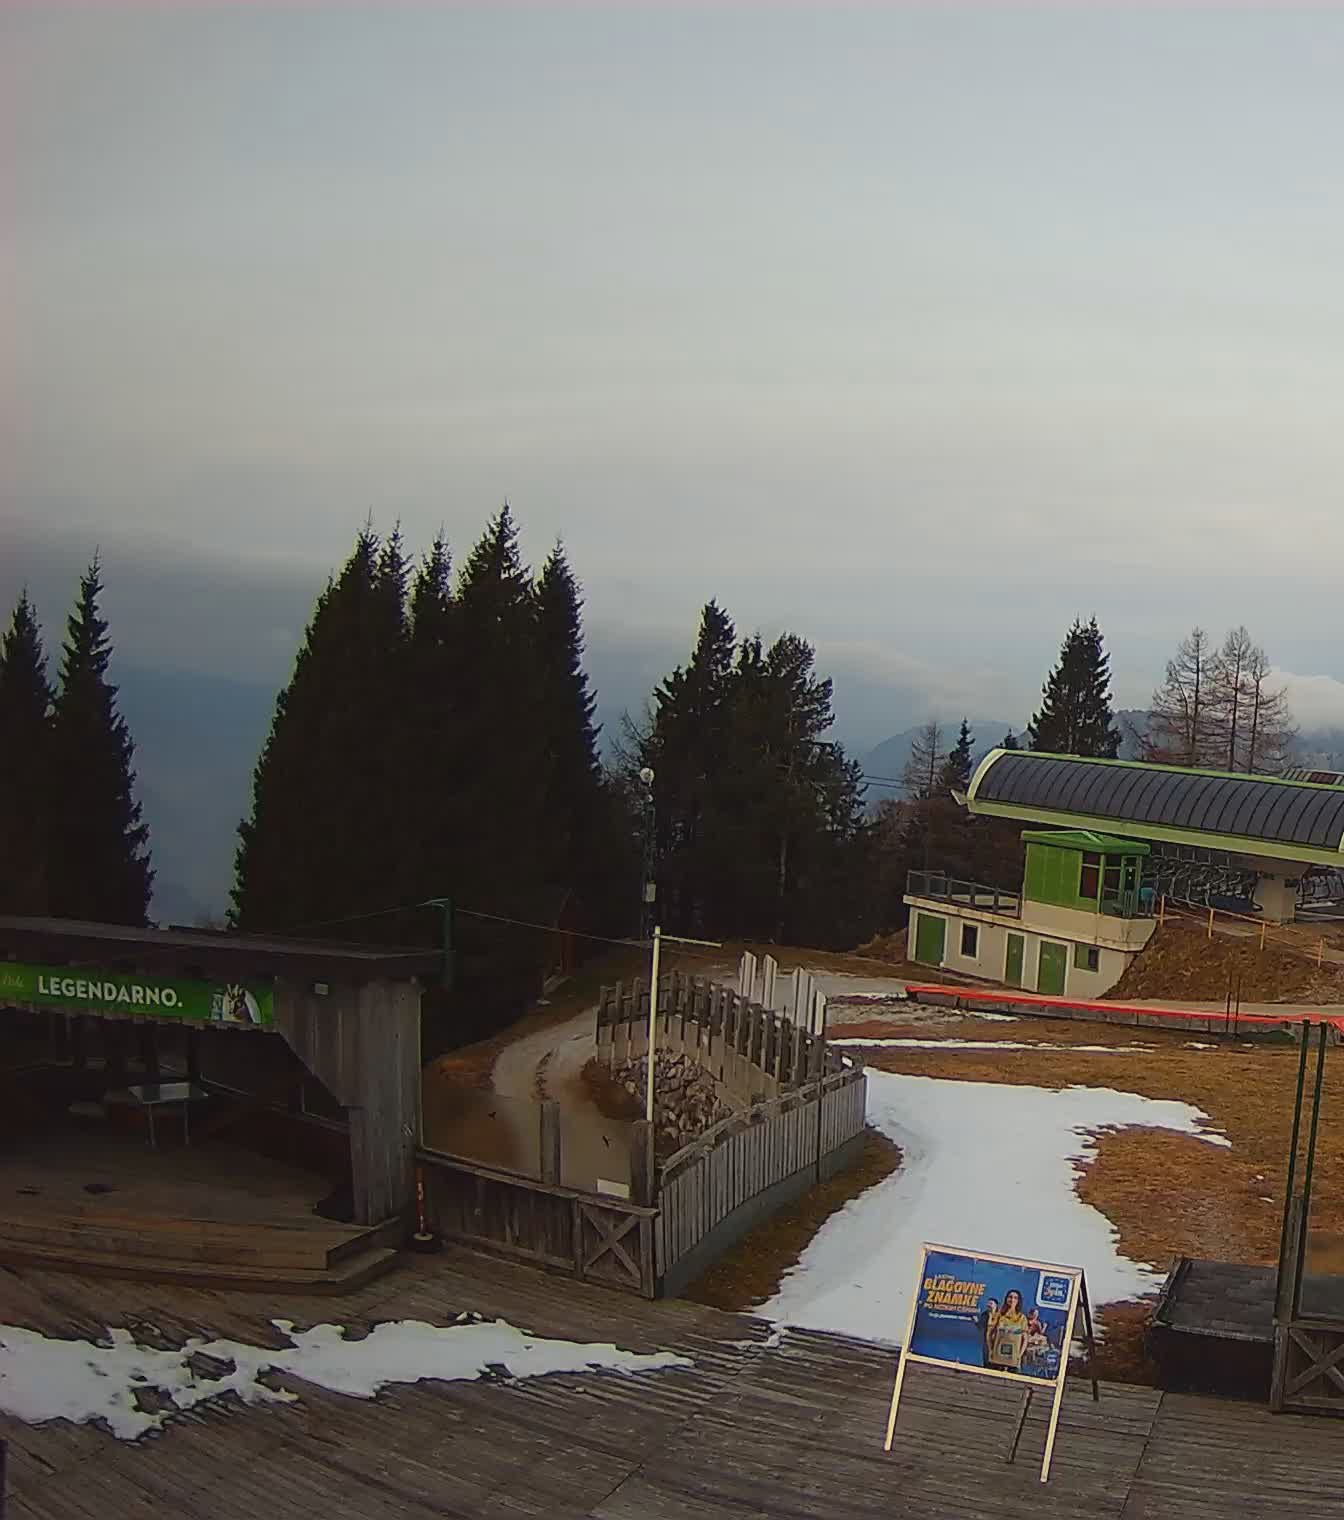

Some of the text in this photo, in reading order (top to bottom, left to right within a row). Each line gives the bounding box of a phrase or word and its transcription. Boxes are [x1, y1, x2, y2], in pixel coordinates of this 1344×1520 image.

[38, 976, 183, 1008] LEGENDARNO.
[924, 1278, 985, 1295] BLAGOVNE
[927, 1291, 979, 1307] ZNAMKE
